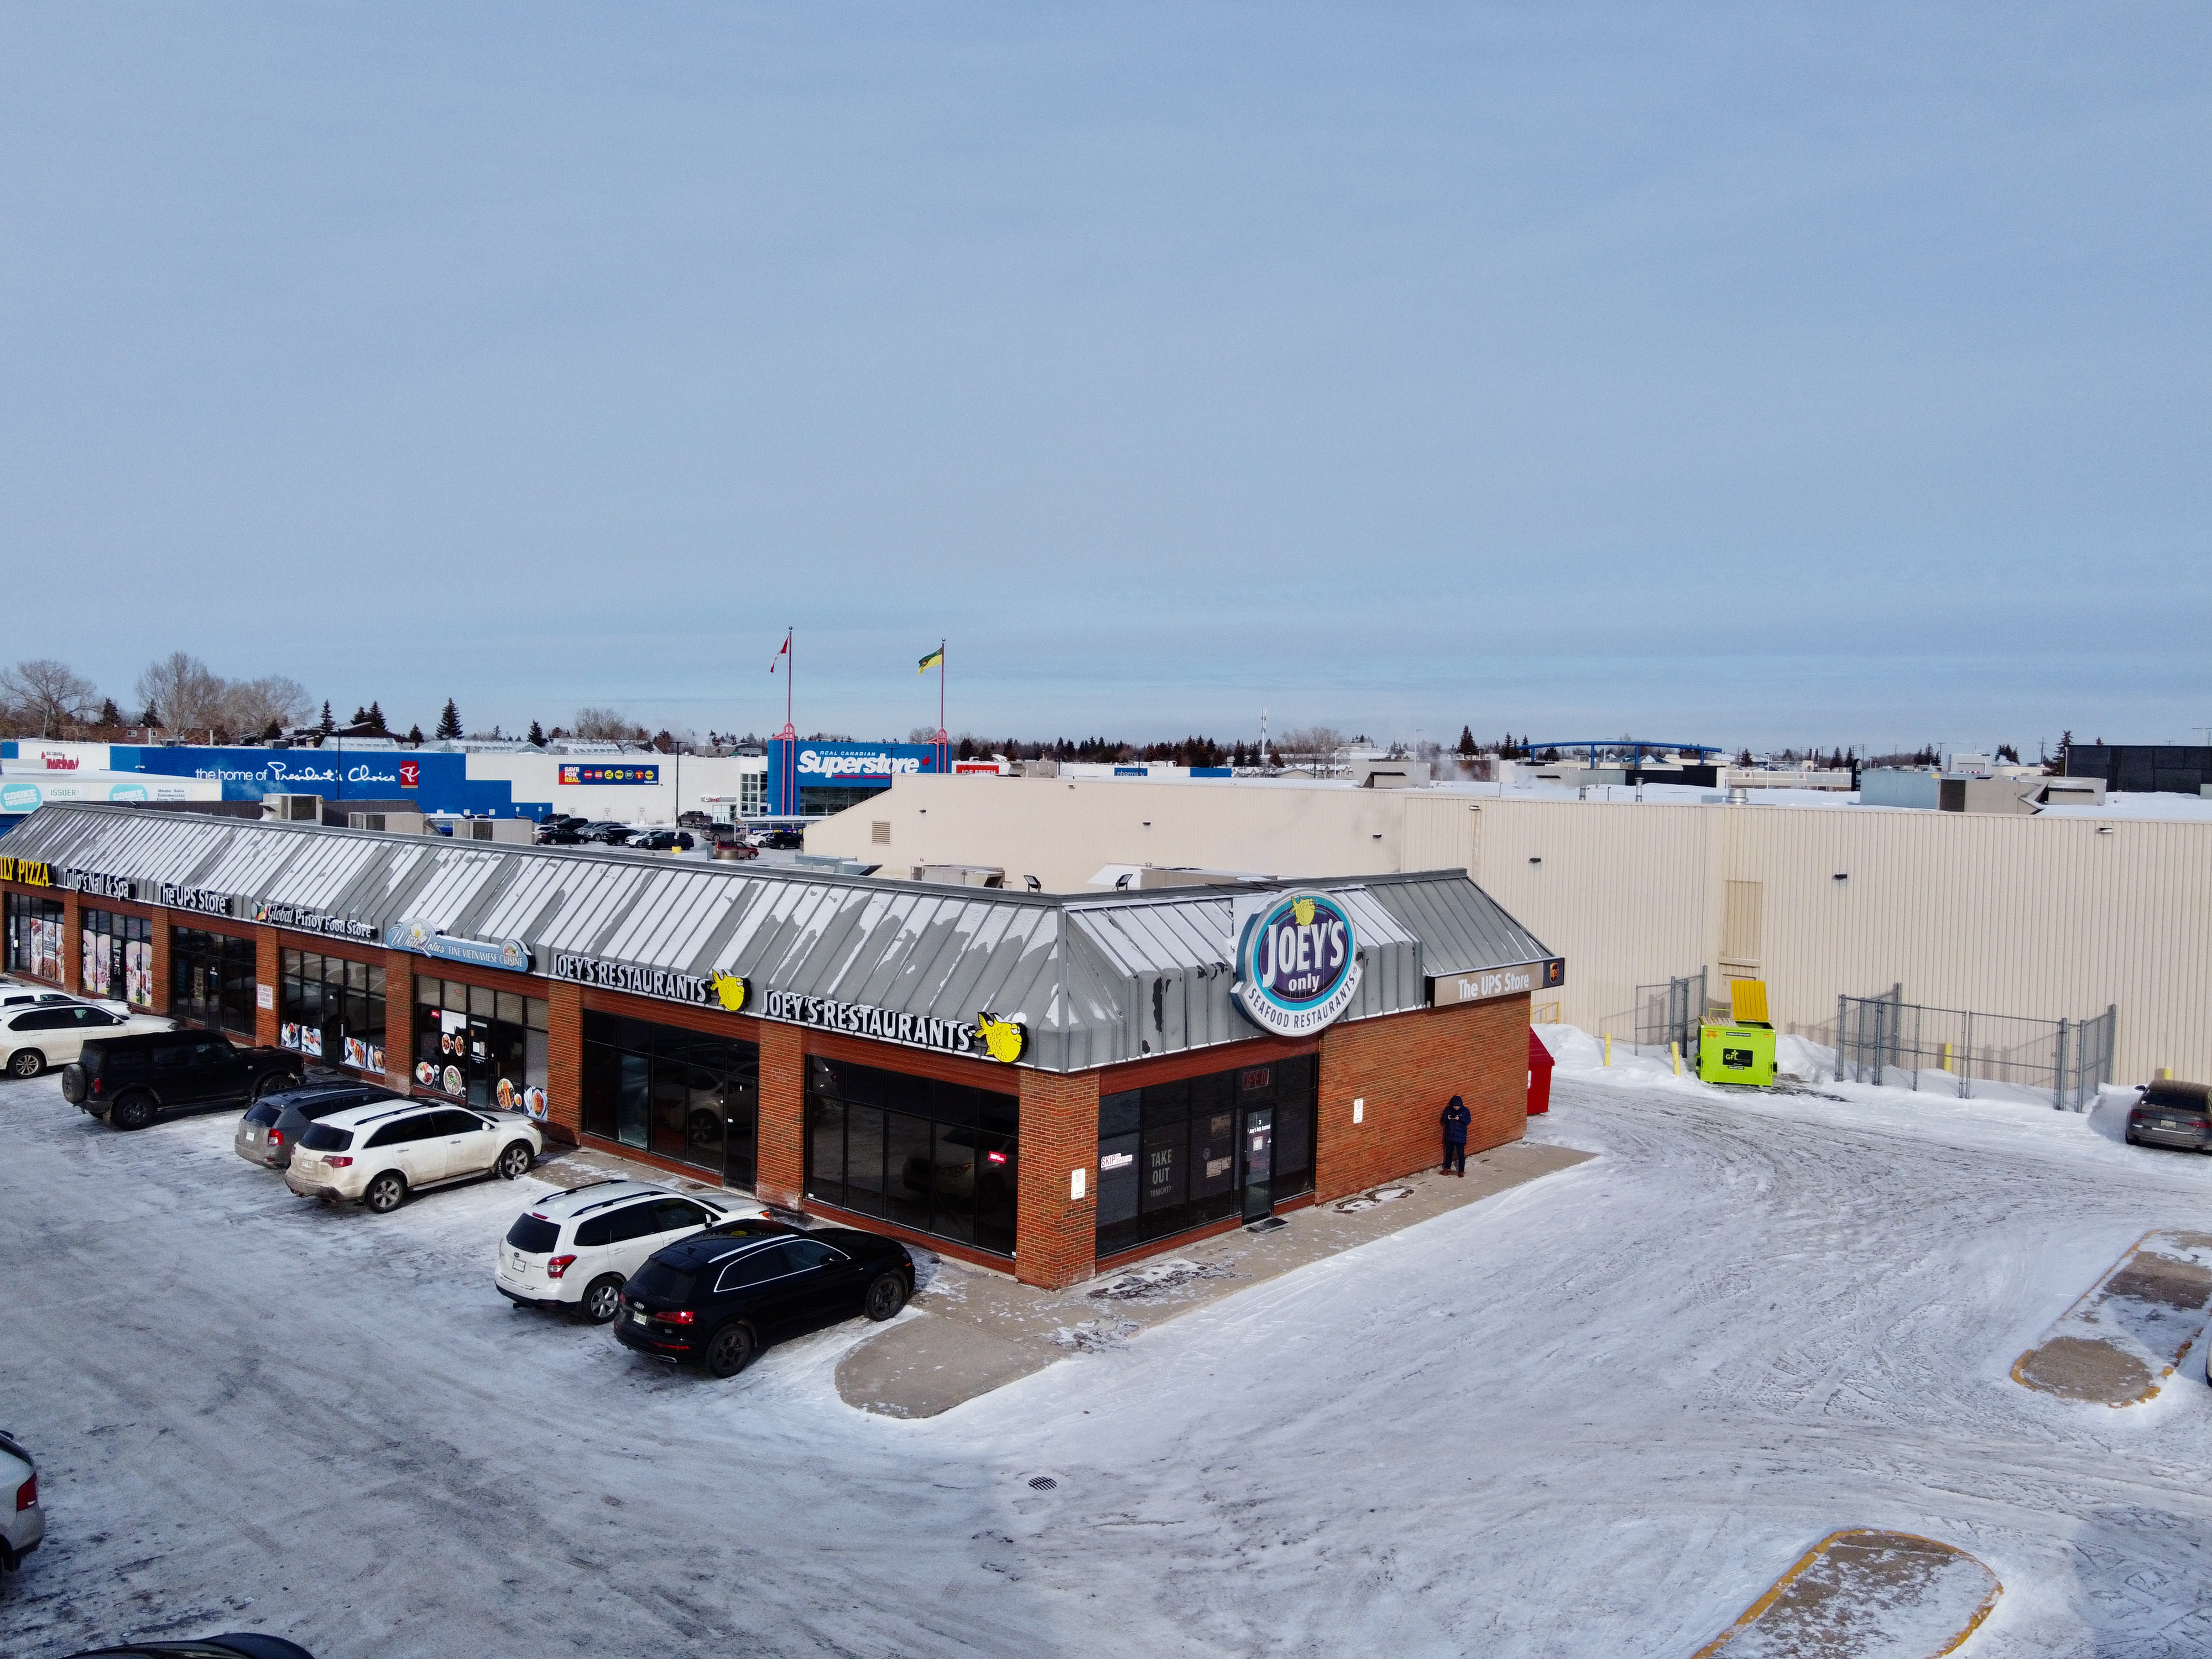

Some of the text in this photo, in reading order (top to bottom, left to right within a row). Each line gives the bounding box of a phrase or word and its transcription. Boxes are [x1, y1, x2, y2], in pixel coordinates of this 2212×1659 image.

[195, 768, 268, 781] the home of
[267, 761, 396, 782] President's Choice
[797, 750, 919, 778] Superstore
[4, 789, 37, 801] COOKE
[5, 796, 38, 806] INSURED
[113, 789, 144, 801] COOKE
[18, 859, 49, 887] PIZZA
[63, 867, 129, 901] Tulip's Nail & Spa
[157, 882, 226, 913] The UPS Store
[268, 904, 371, 937] Global Pinoy Food Store
[390, 926, 446, 957] White Lotus
[448, 946, 523, 967] FINE VIETNAMESE CUISINE
[1262, 918, 1344, 988] JOEY'S
[551, 954, 707, 1003] JOEY'S RESTAURANTS
[1288, 972, 1320, 992] only
[1458, 972, 1529, 999] The UPS Store
[1248, 973, 1355, 1029] SEAFOOD RESTAURANTS
[760, 989, 969, 1051] JOEY'S RESTAURANTS
[1725, 1051, 1738, 1060] GFL
[1243, 1070, 1268, 1089] OPEN
[1102, 1155, 1116, 1166] SKIP
[1151, 1149, 1172, 1168] TAKE
[1152, 1167, 1170, 1185] OUT
[1150, 1185, 1171, 1198] TONIGHT?
